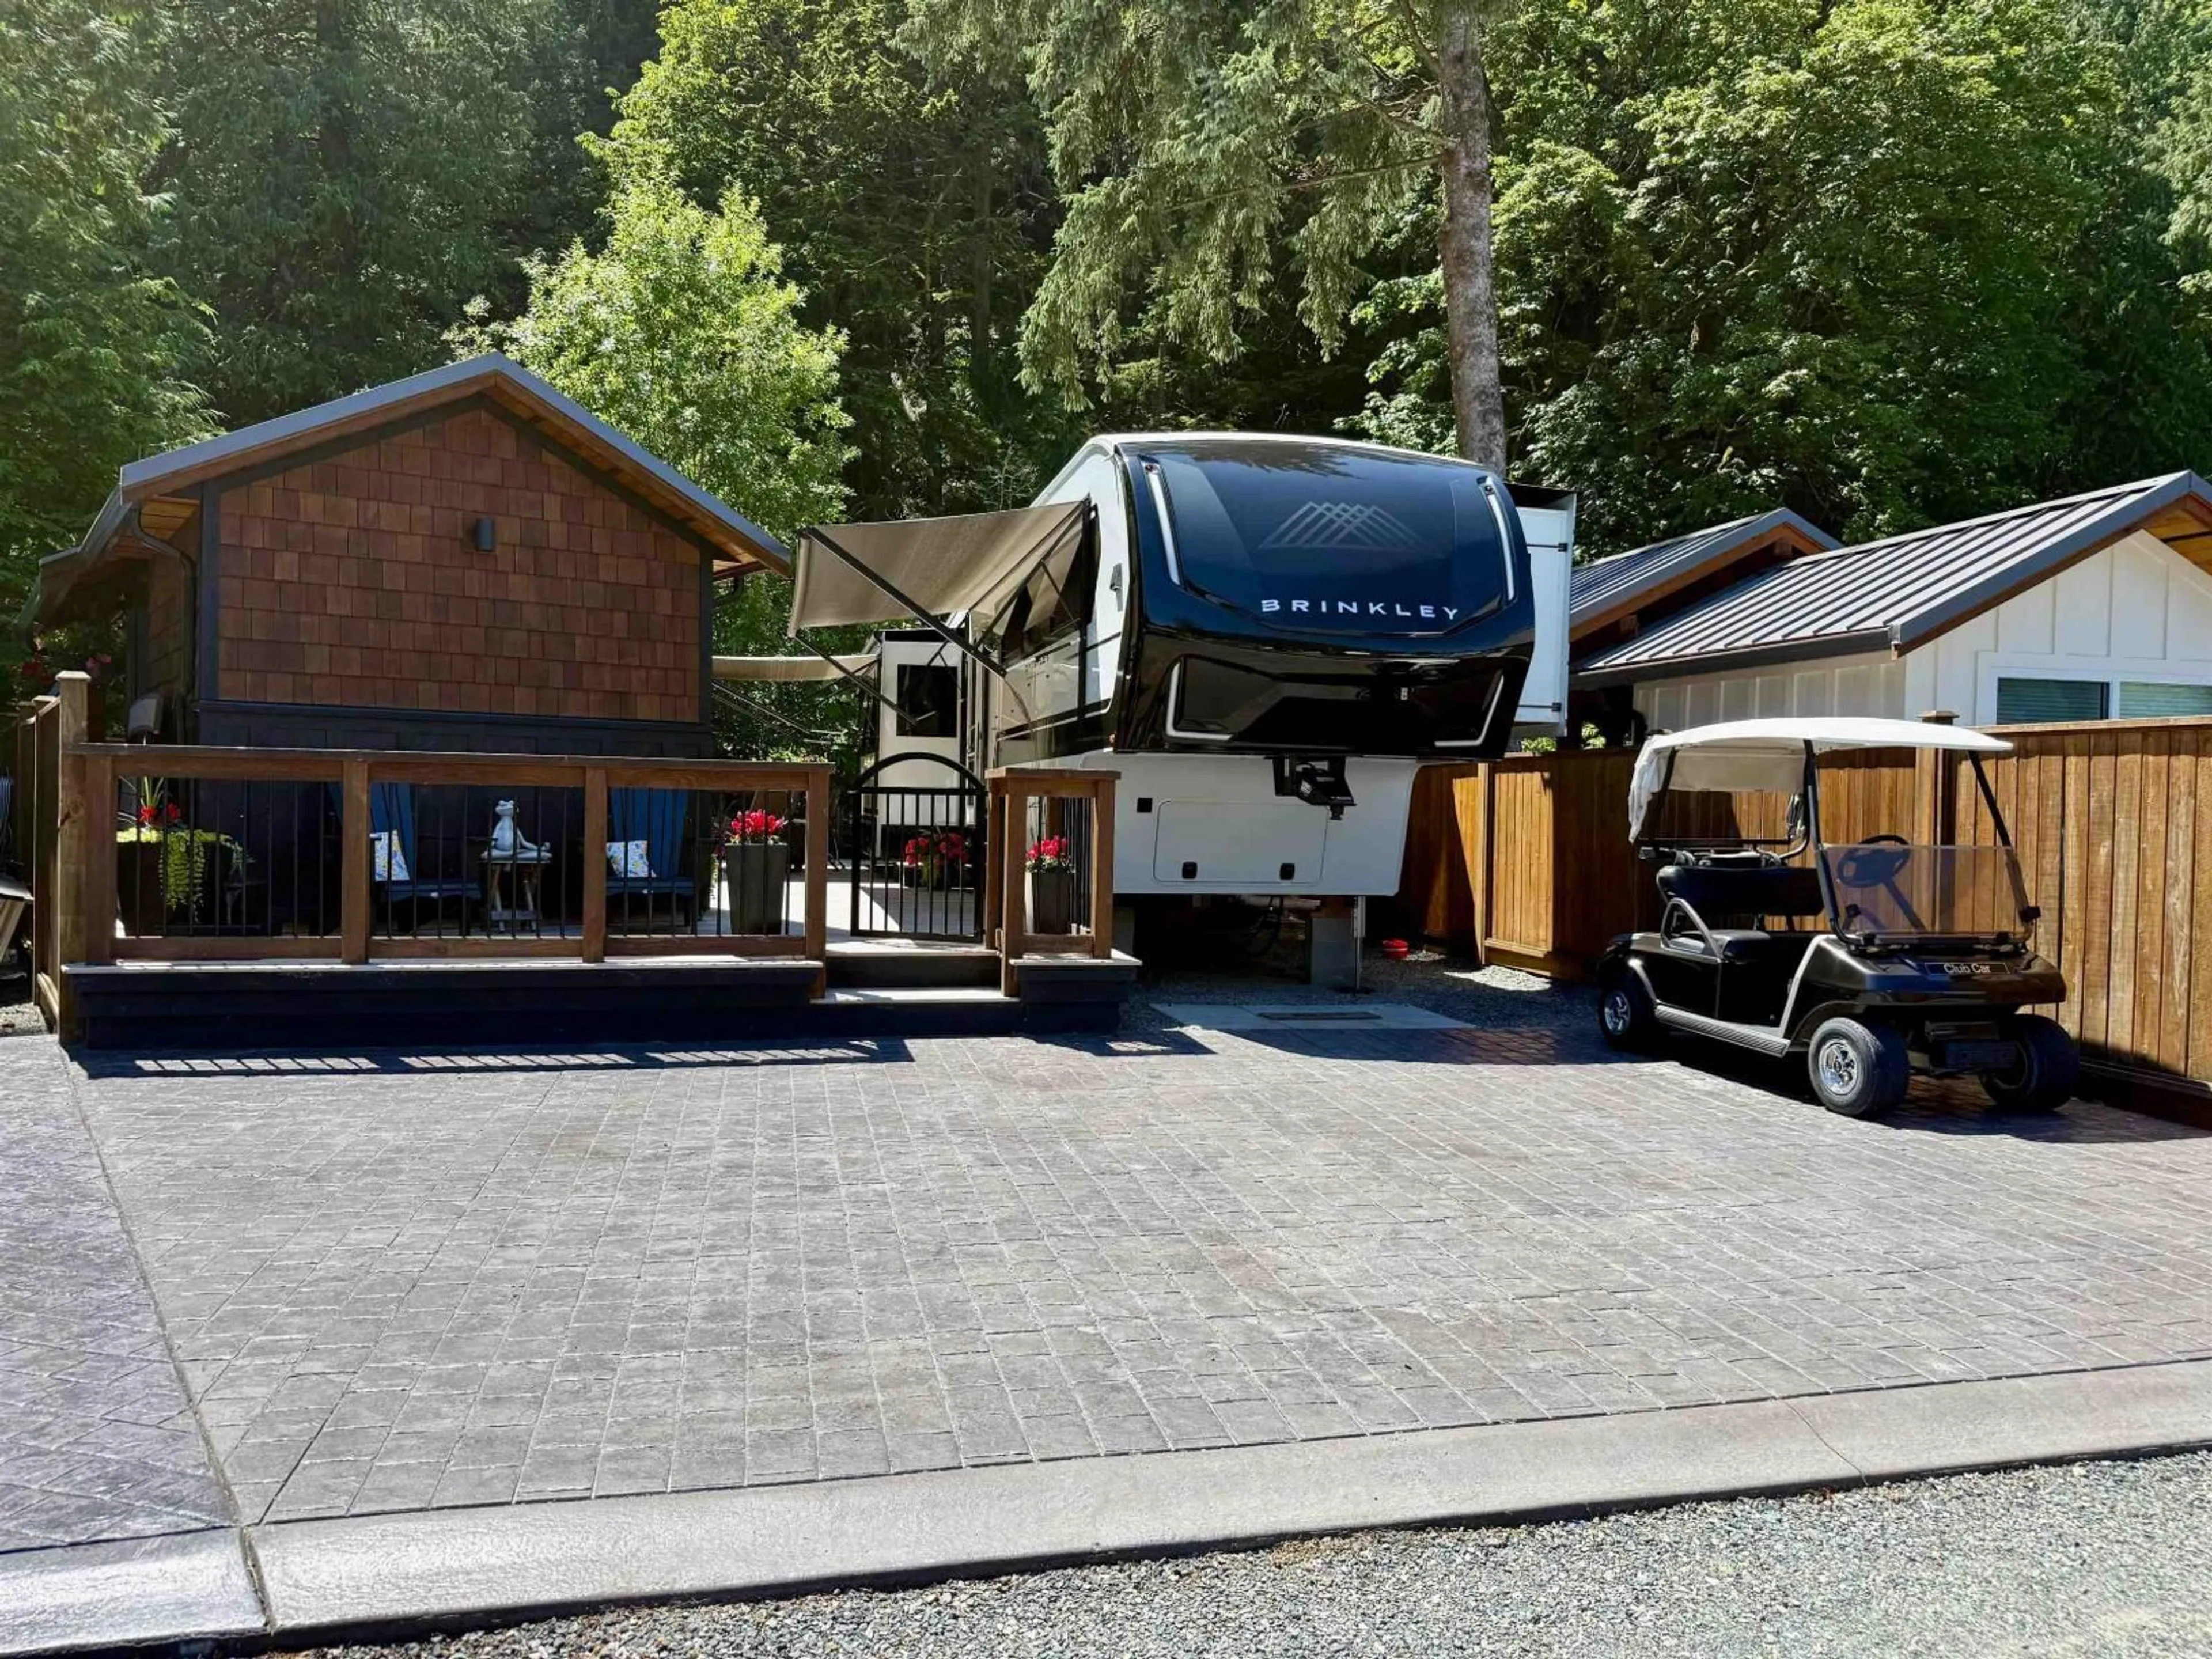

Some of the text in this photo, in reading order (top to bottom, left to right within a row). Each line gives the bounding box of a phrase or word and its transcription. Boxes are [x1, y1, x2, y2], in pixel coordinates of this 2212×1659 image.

[1260, 599, 1458, 620] BRINKLEY
[1944, 963, 1991, 973] Club Car
